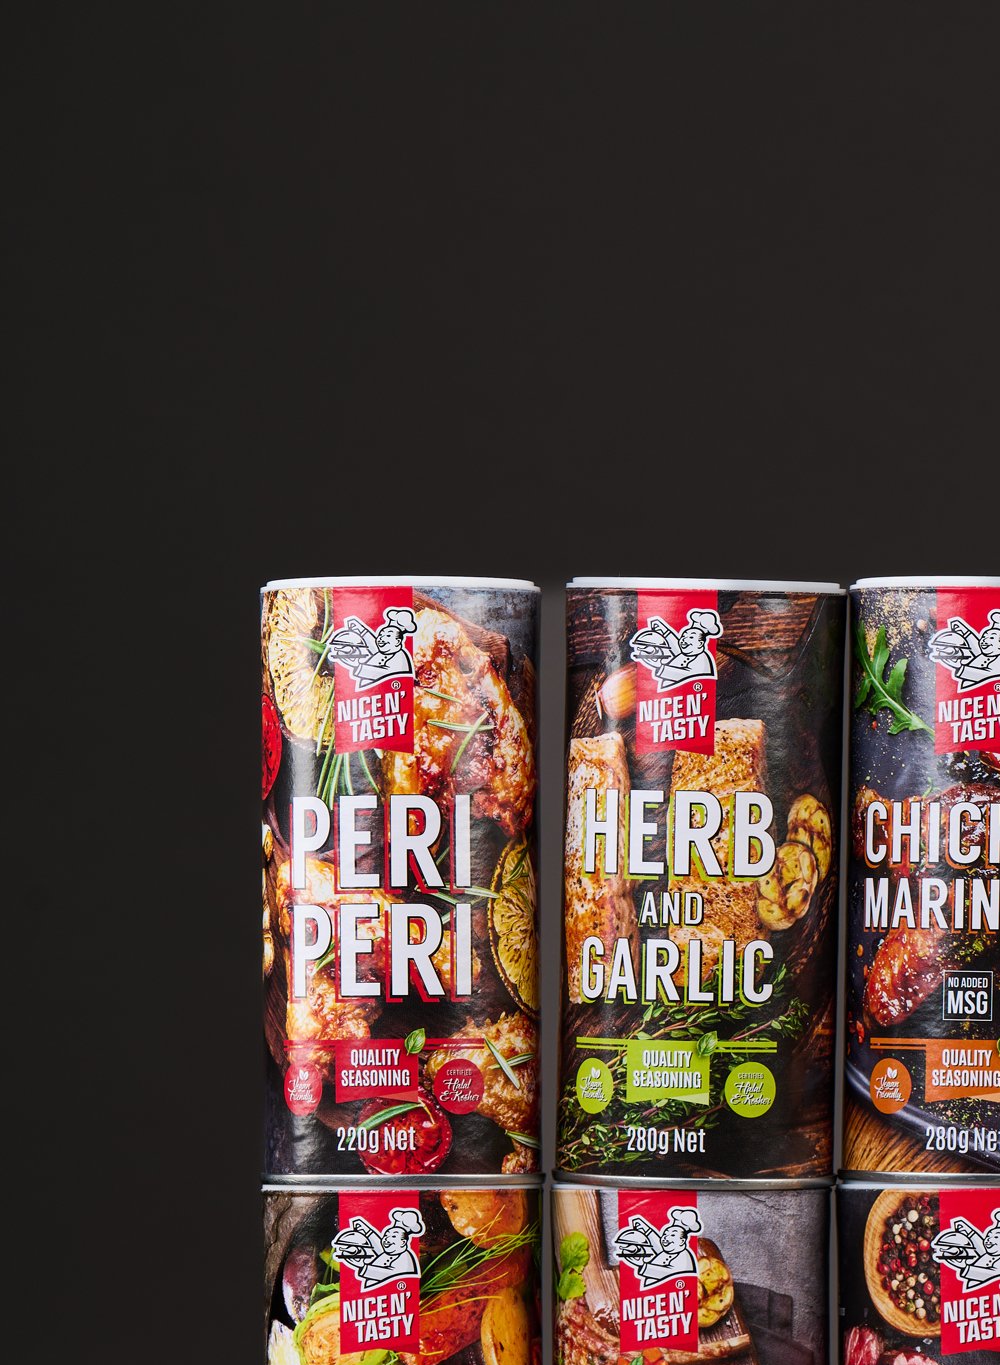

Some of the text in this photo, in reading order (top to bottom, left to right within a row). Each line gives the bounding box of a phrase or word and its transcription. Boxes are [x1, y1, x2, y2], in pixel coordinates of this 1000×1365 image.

[337, 691, 406, 723] NICE N'
[938, 696, 983, 722] NICE
[350, 714, 408, 743] TASTY
[293, 795, 471, 888] PERI
[585, 788, 775, 876] HERB
[640, 891, 703, 925] AND
[293, 904, 472, 997] PERI
[581, 937, 774, 1003] GARLIC
[948, 978, 988, 988] NO ADDED
[948, 992, 988, 1014] MSG
[350, 1049, 400, 1066] QUALITY
[643, 1051, 692, 1068] QUALITY
[942, 1049, 992, 1067] QUALITY
[341, 1070, 410, 1087] SEASONING
[633, 1072, 702, 1089] SEASONING
[932, 1070, 1000, 1088] SEASONING
[337, 1126, 416, 1153] 220g Net
[628, 1128, 705, 1154] 280g Net
[925, 1126, 968, 1153] 280g
[944, 1297, 990, 1323] NICE
